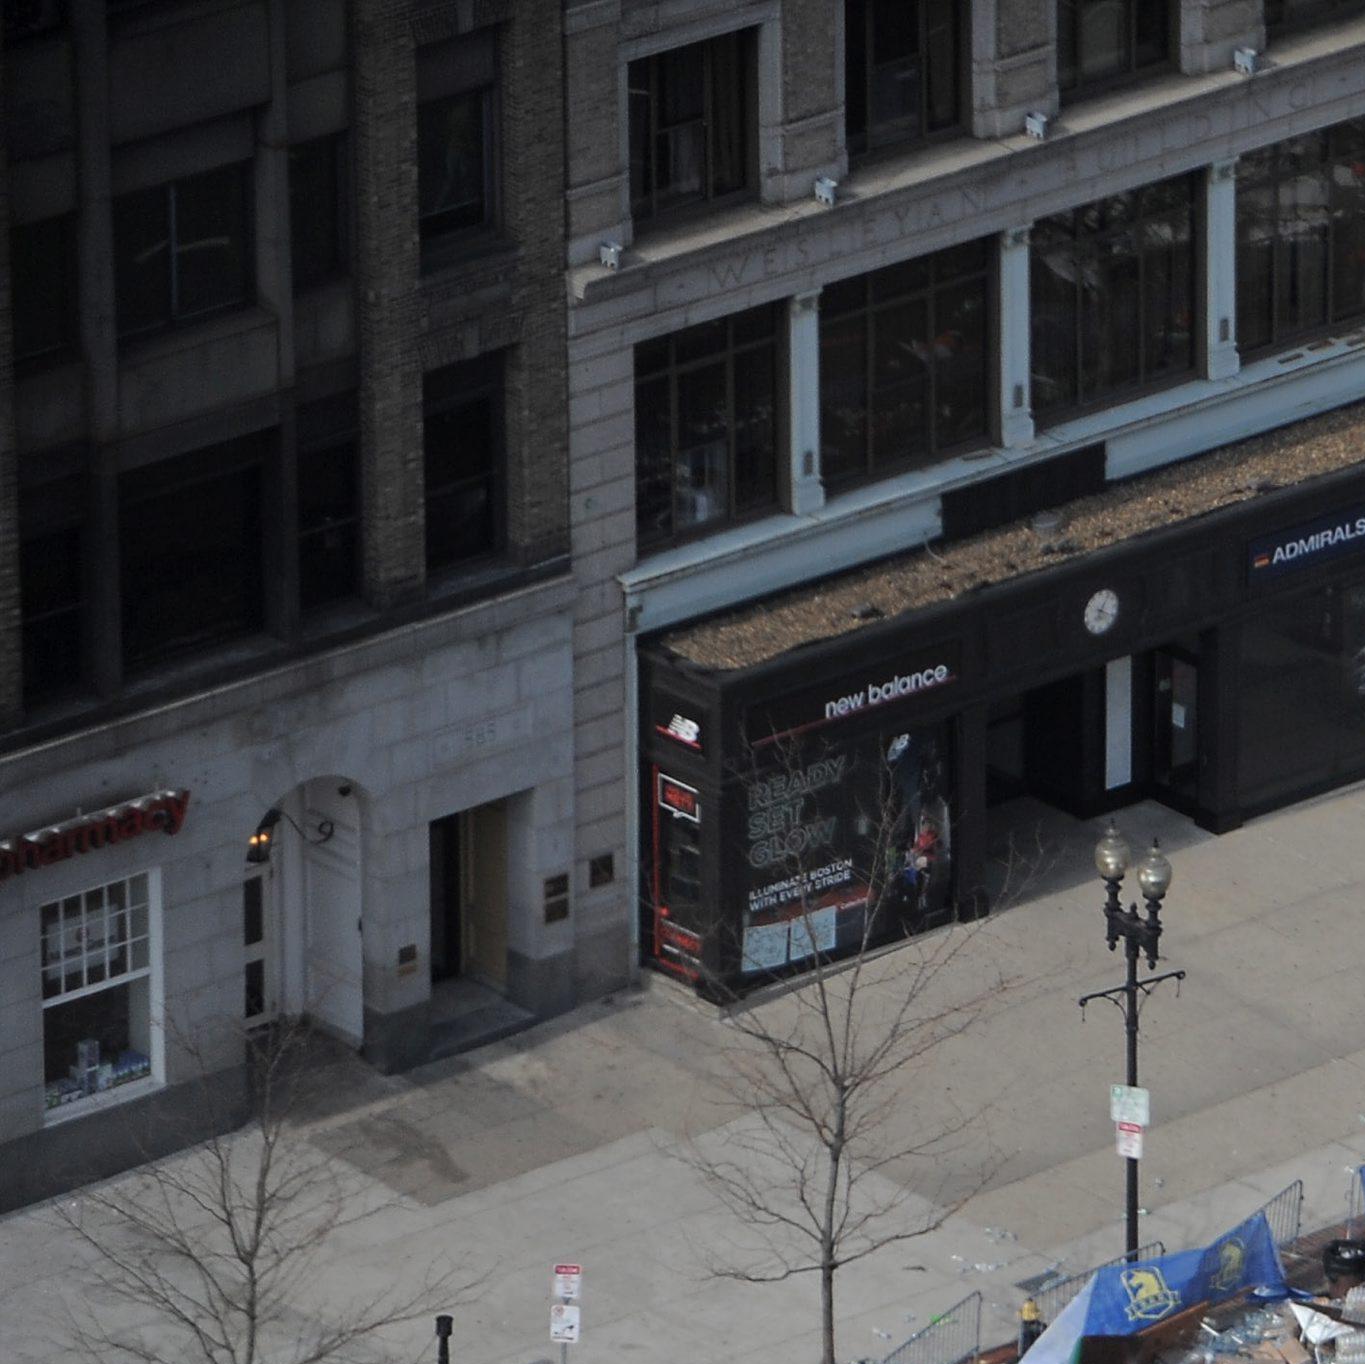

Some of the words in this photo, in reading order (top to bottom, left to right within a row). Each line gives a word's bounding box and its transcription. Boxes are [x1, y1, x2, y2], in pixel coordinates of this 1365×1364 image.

[1272, 518, 1348, 564] ADMIRALS
[825, 694, 865, 720] new
[868, 664, 948, 704] balance
